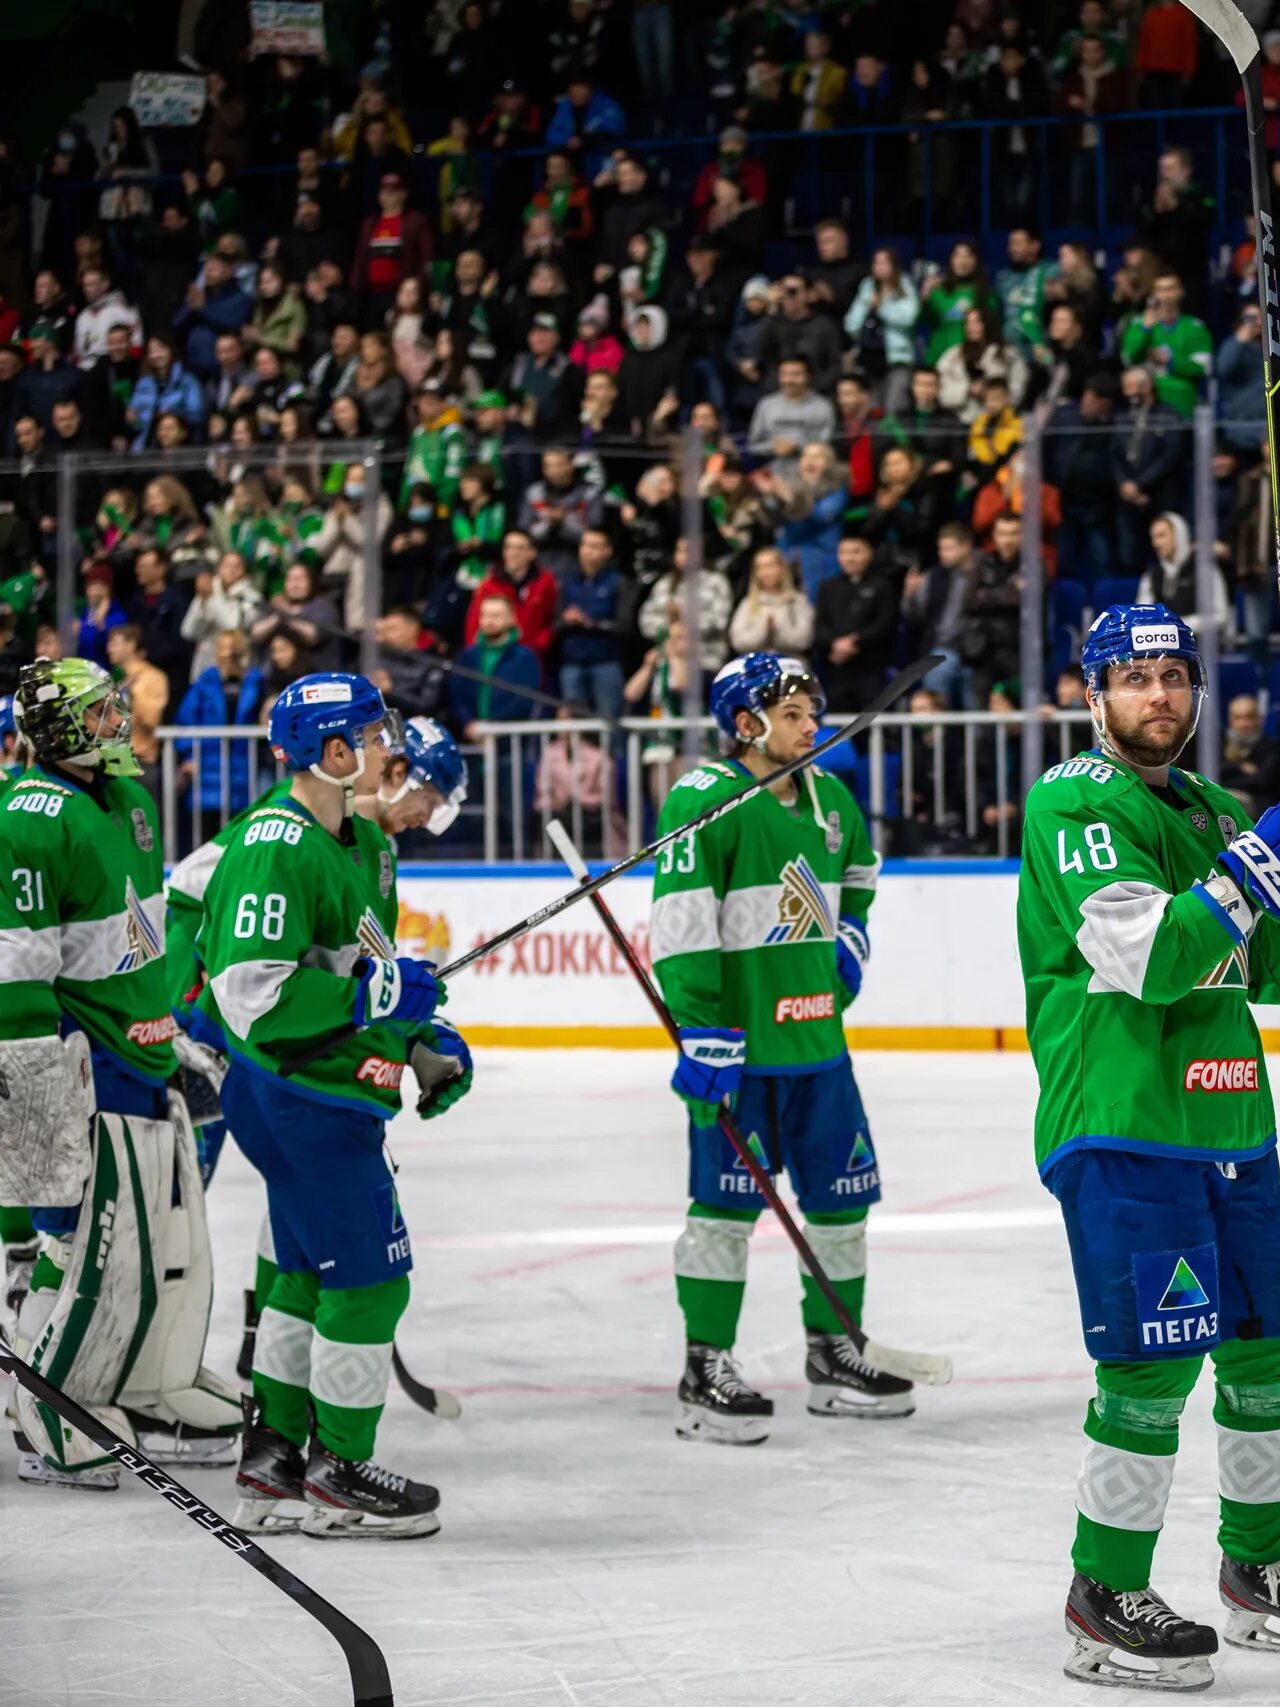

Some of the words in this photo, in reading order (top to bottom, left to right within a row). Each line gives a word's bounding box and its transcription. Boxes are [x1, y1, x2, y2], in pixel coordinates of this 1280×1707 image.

[1058, 822, 1118, 875] 48
[11, 867, 45, 912] 31
[234, 893, 287, 941] 68
